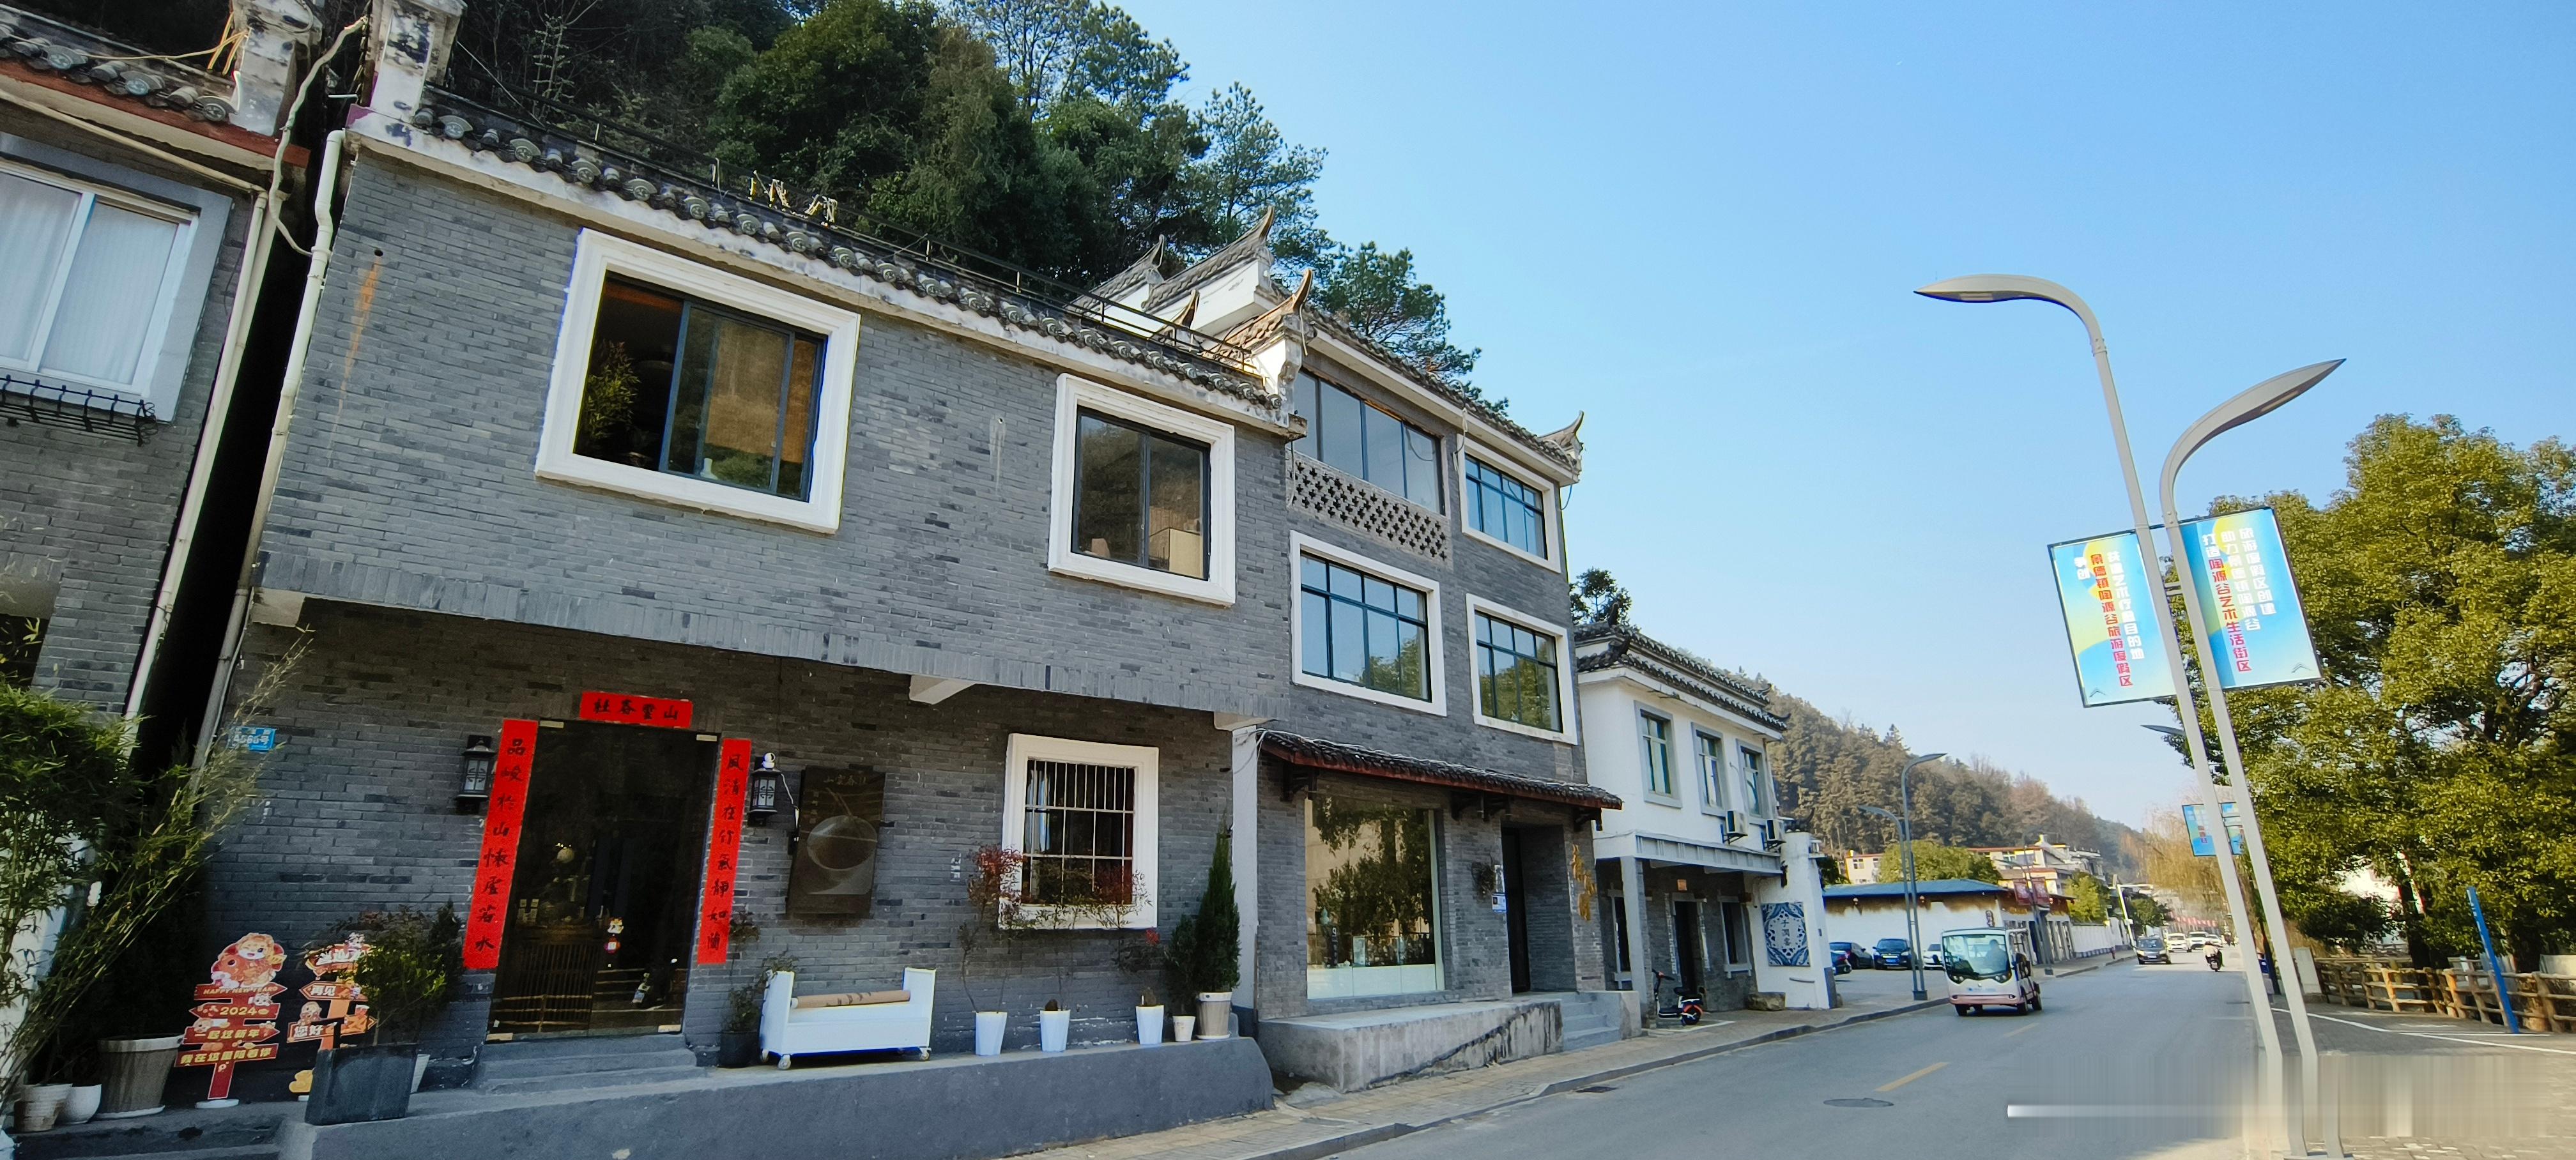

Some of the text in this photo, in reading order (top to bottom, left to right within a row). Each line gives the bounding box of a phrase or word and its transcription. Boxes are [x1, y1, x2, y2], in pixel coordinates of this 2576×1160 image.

[310, 984, 337, 996] 再见
[220, 1007, 257, 1016] 2024
[294, 1025, 323, 1038] 您好
